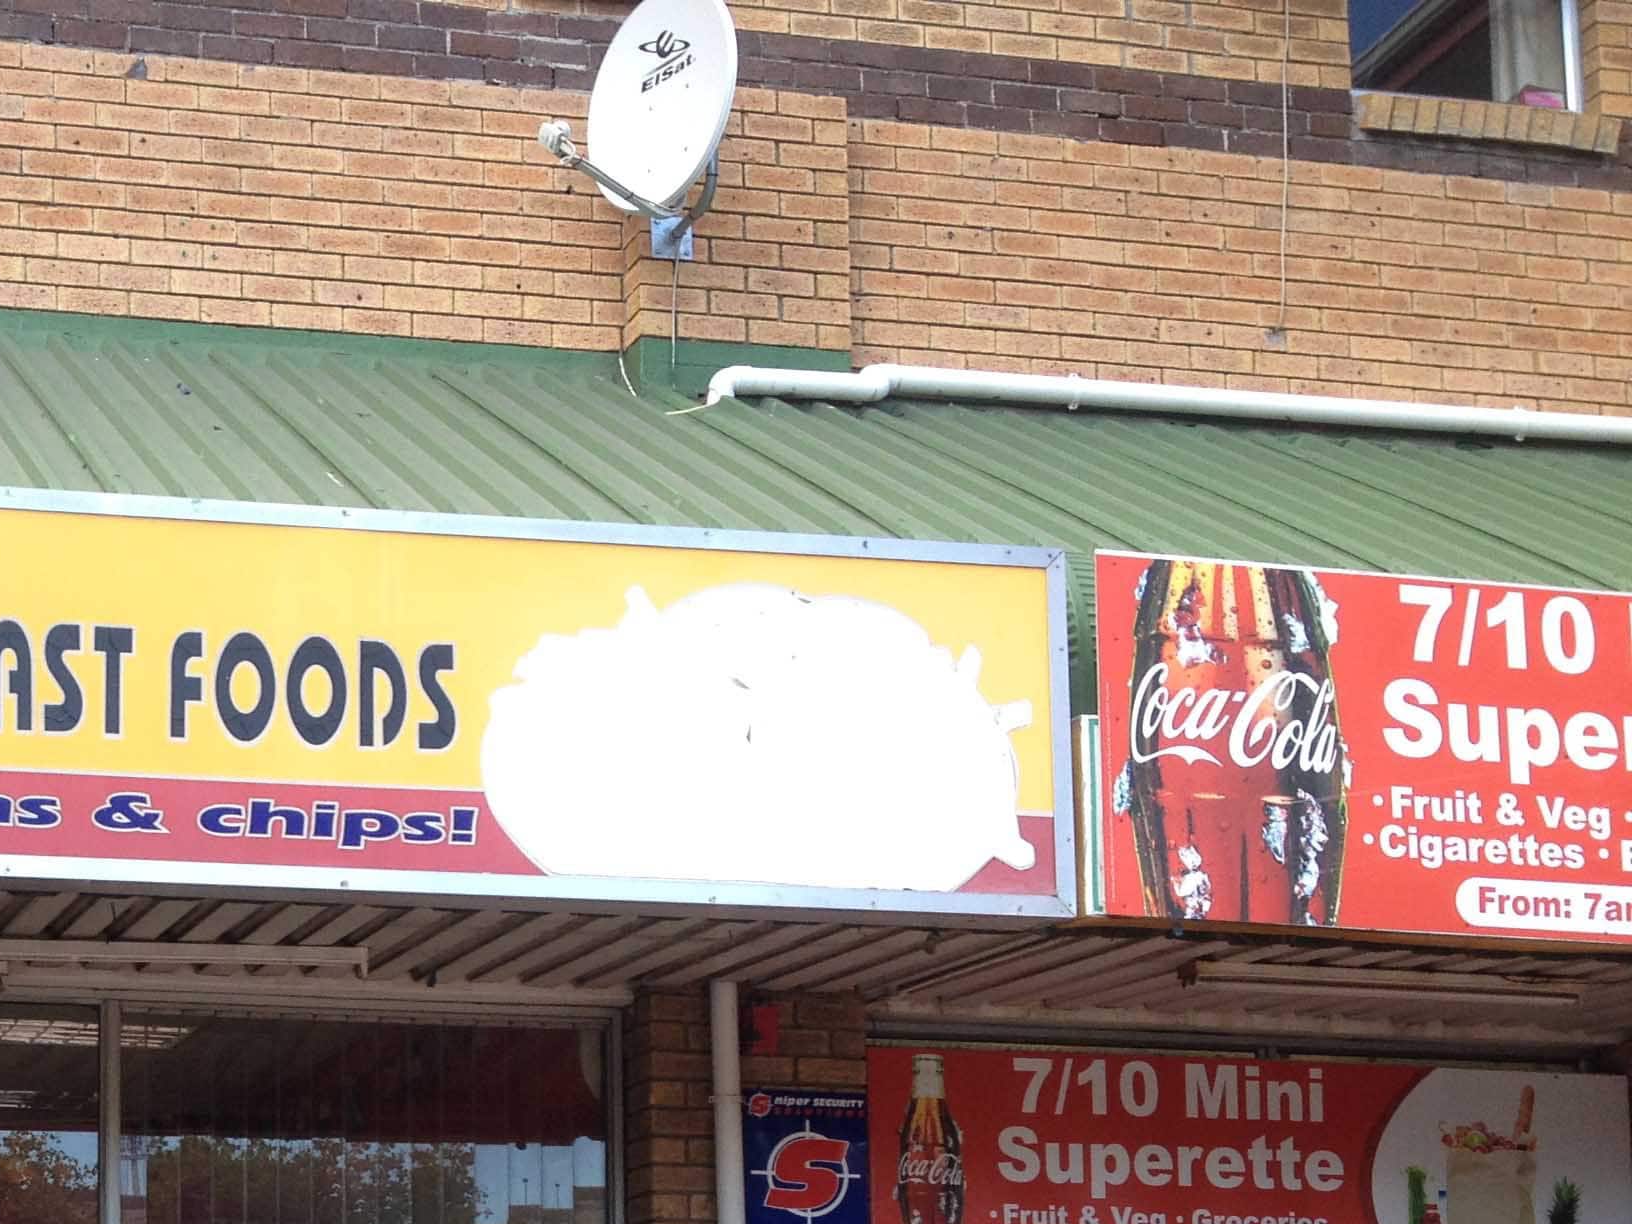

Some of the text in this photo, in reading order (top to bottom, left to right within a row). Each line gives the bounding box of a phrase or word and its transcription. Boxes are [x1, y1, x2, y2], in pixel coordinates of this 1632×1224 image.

[1399, 583, 1596, 675] 7/10
[168, 628, 459, 754] FOODS
[1131, 661, 1339, 775] Coca-Cola
[92, 792, 167, 834] &
[197, 797, 479, 850] chips!
[1390, 785, 1611, 840] Fruit & Veg
[1379, 824, 1585, 869] Cigarettes
[1478, 886, 1632, 922] From: 7a
[1012, 1057, 1324, 1122] 7/10 Mini
[998, 1126, 1345, 1199] Superette
